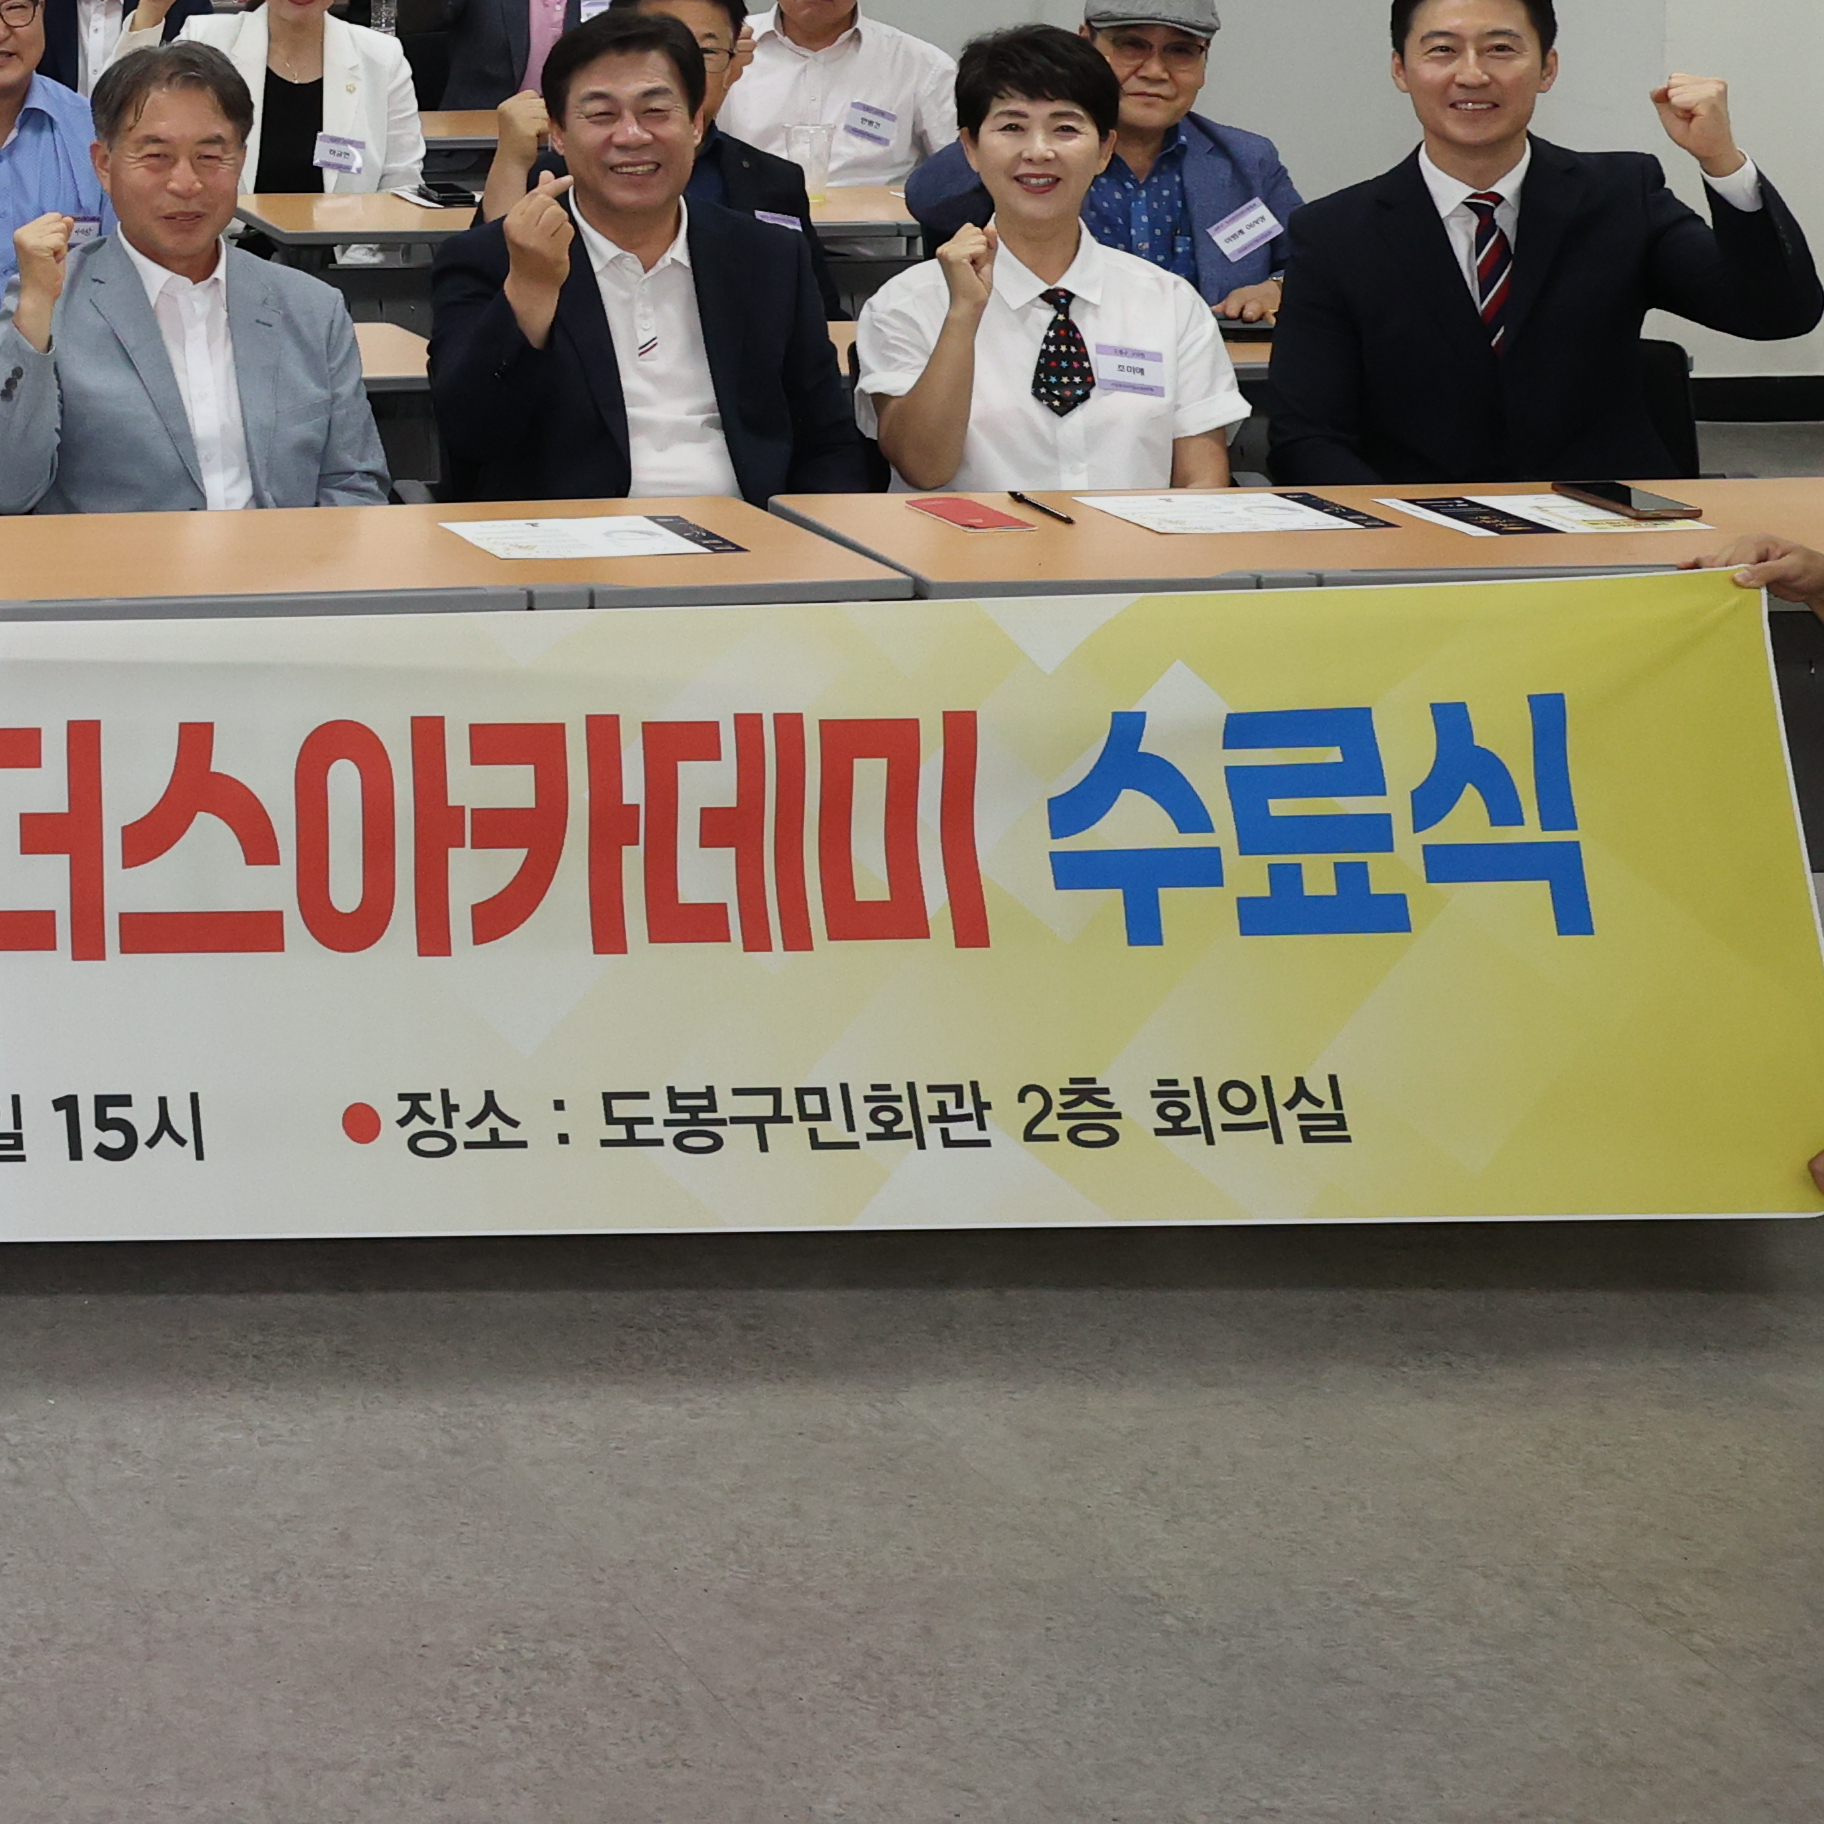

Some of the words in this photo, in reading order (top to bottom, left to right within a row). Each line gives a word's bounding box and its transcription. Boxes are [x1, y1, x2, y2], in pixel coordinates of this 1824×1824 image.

[1117, 364, 1145, 376] 조미애
[1048, 693, 1594, 946] 수료식
[52, 1092, 204, 1161] 15시
[397, 1089, 528, 1158] 장소
[600, 1081, 991, 1154] 도봉구민회관
[1018, 1077, 1121, 1149] 2층
[1150, 1074, 1351, 1145] 회의실
